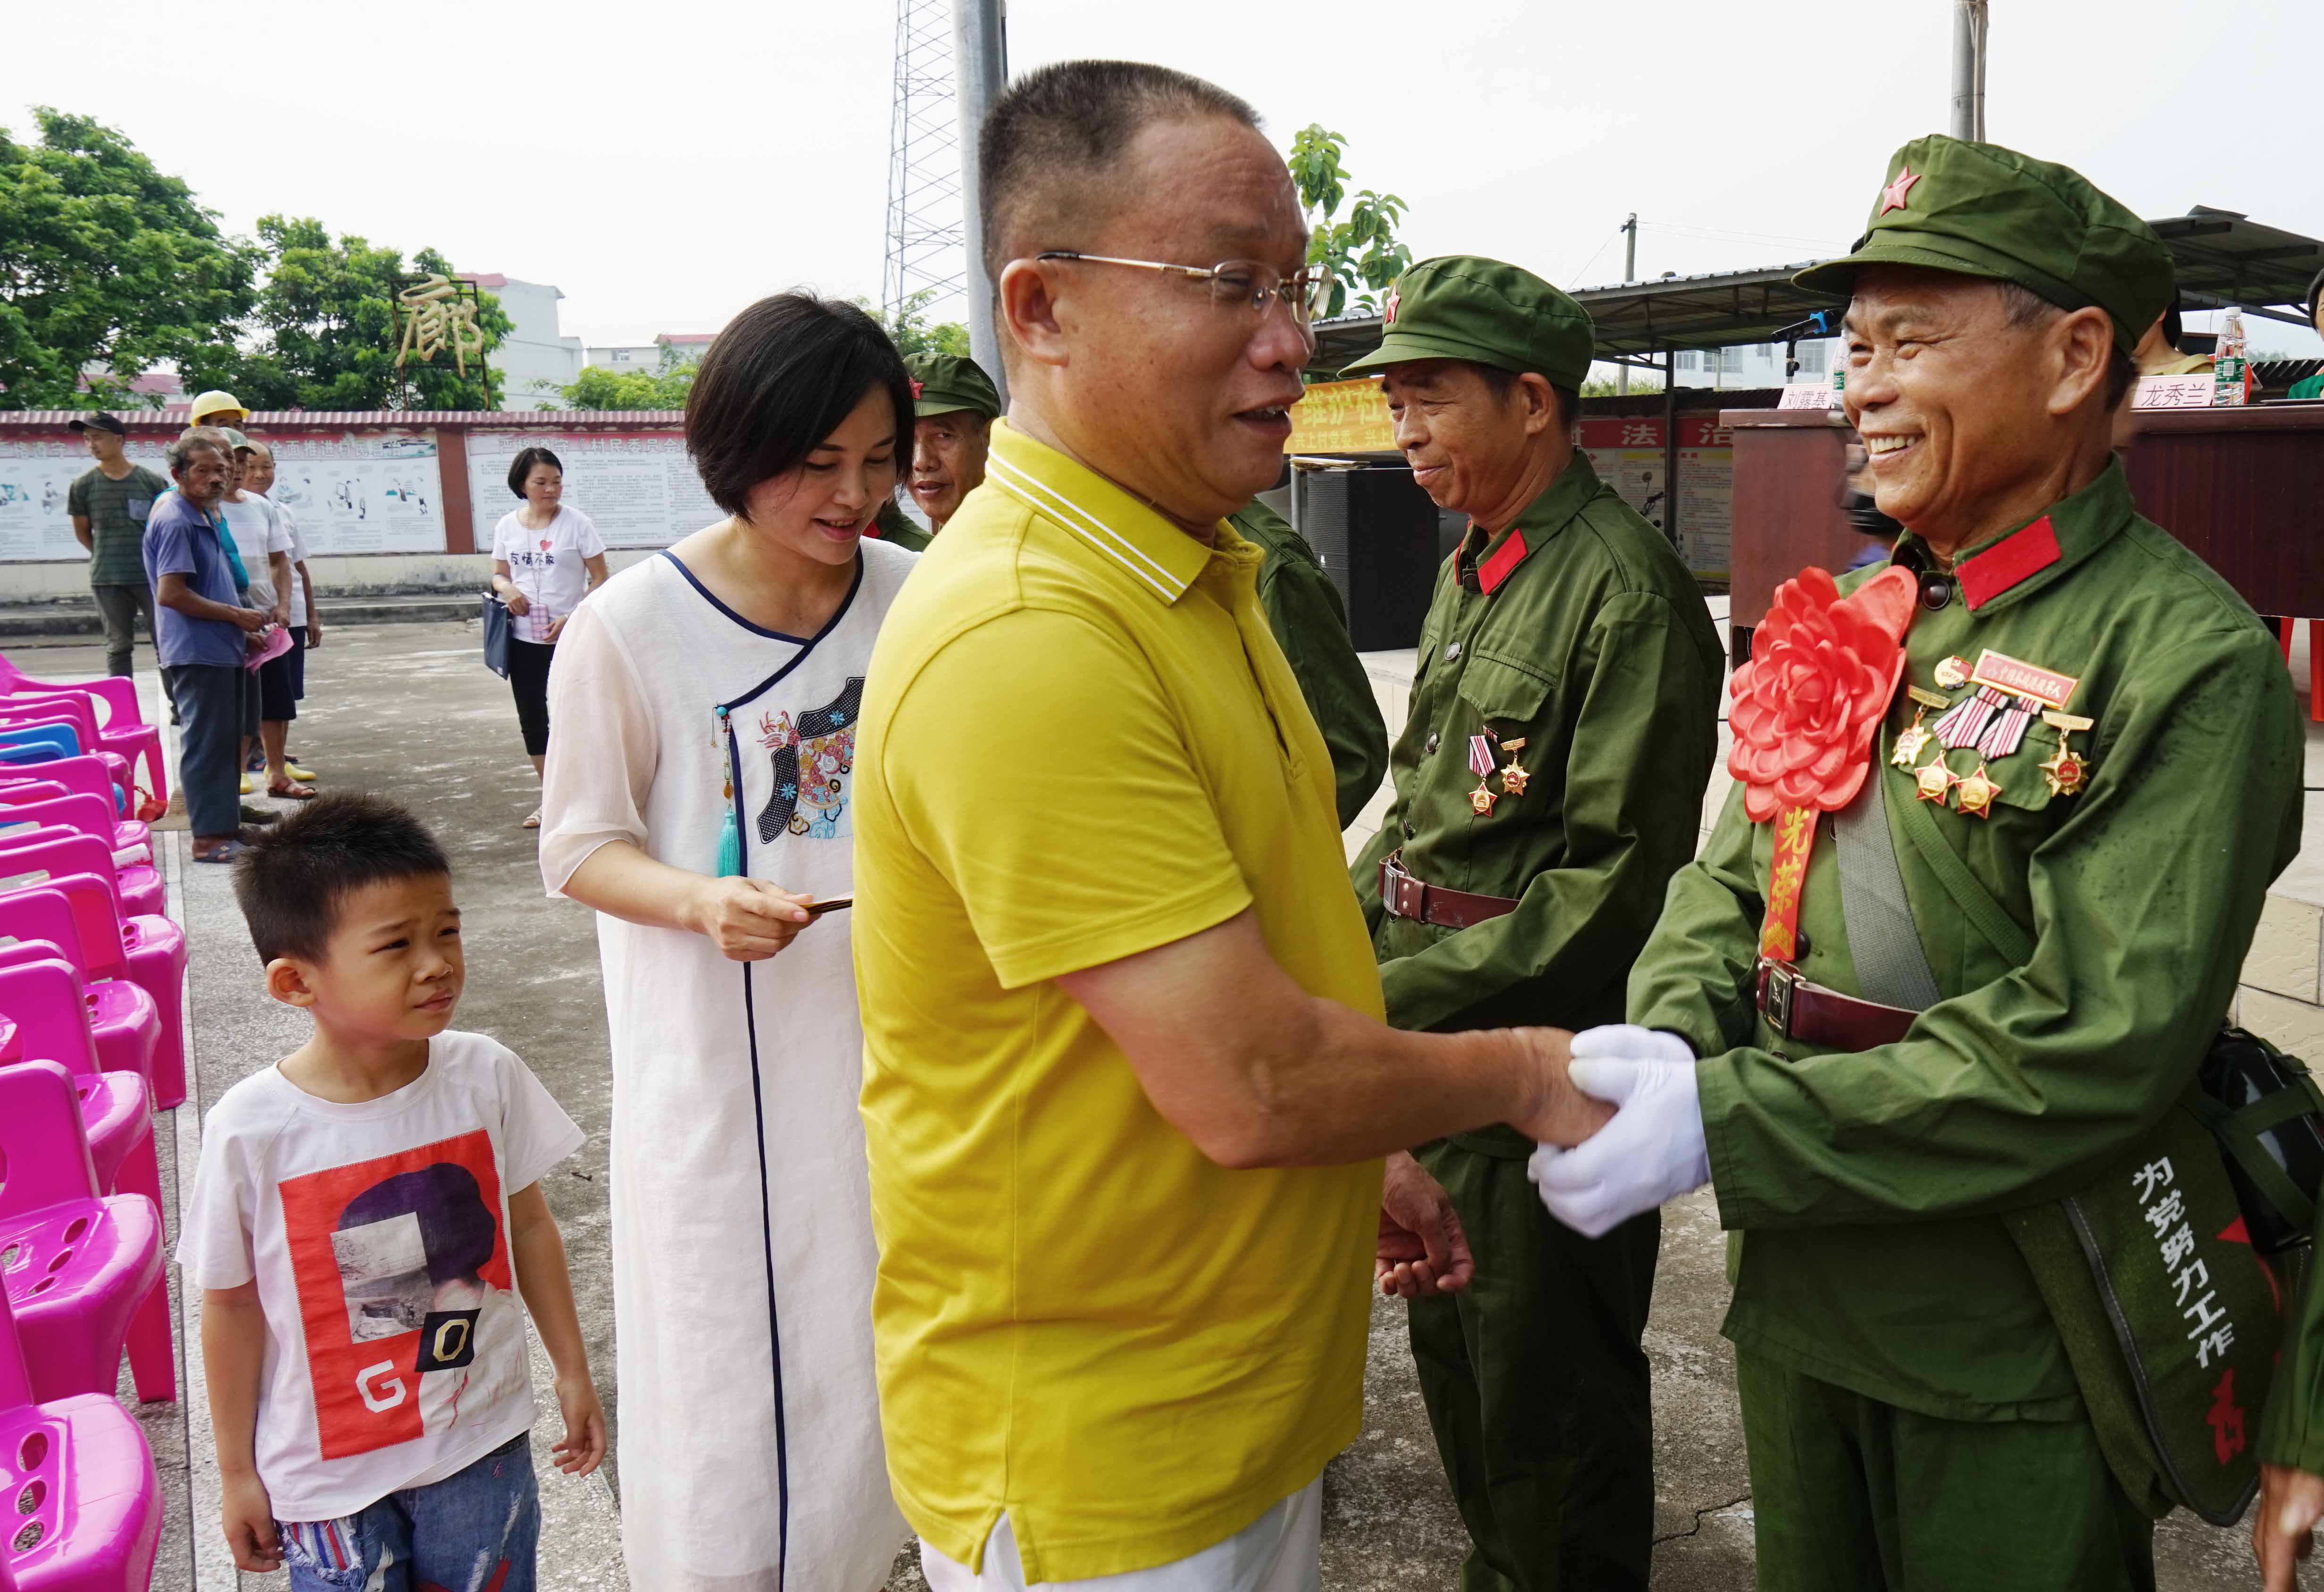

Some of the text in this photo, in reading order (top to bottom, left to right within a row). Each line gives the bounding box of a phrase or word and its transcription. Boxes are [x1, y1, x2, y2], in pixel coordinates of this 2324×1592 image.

[394, 273, 483, 378] 廊
[1298, 382, 1392, 428] 维护社
[1785, 390, 1828, 409] 刘露基
[2141, 382, 2206, 406] 龙秀兰
[270, 439, 401, 457] 全面推进村民自治
[1771, 806, 1810, 916] 光荣
[2132, 1156, 2235, 1368] 为党努力工作
